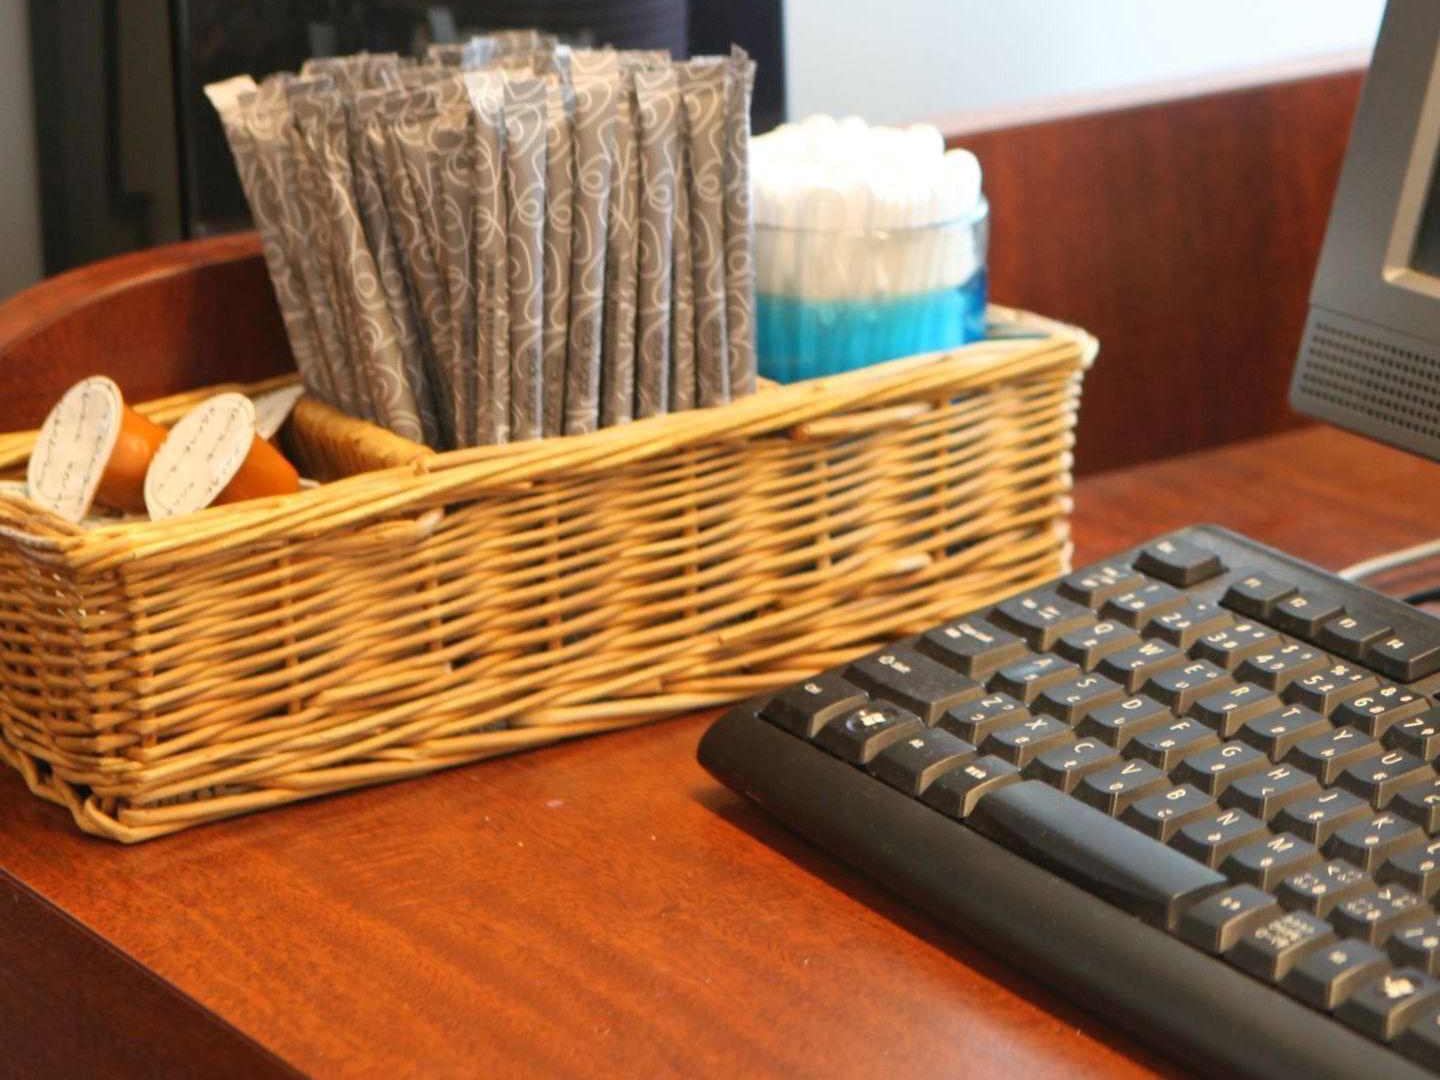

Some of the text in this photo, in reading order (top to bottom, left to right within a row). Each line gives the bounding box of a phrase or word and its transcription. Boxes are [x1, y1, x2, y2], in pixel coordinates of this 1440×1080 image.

[1290, 598, 1307, 608] F2
[1162, 613, 1185, 626] 2
[1339, 619, 1356, 628] F3
[1094, 624, 1114, 634] Q
[1208, 633, 1227, 641] 3
[1387, 639, 1404, 648] F4
[1139, 644, 1163, 655] W
[1257, 655, 1274, 663] 4
[1184, 665, 1203, 674] E
[1077, 678, 1097, 687] S
[1304, 675, 1323, 684] 5
[1231, 687, 1249, 696] R
[982, 697, 1006, 709] Z
[1122, 699, 1142, 709] D
[1354, 698, 1373, 706] 6
[1282, 708, 1300, 717] T
[1025, 719, 1047, 730] X
[1170, 722, 1190, 730] F
[1404, 719, 1423, 727] 7
[1334, 730, 1353, 740] Y
[1075, 743, 1094, 753] C
[1222, 746, 1242, 757] G
[1382, 753, 1402, 764] U
[1121, 764, 1141, 774] V
[1268, 768, 1289, 780] H
[1167, 789, 1186, 800] B
[1319, 794, 1337, 802] J
[1217, 812, 1239, 825] N
[1372, 816, 1393, 829] K
[1268, 837, 1293, 852] M
